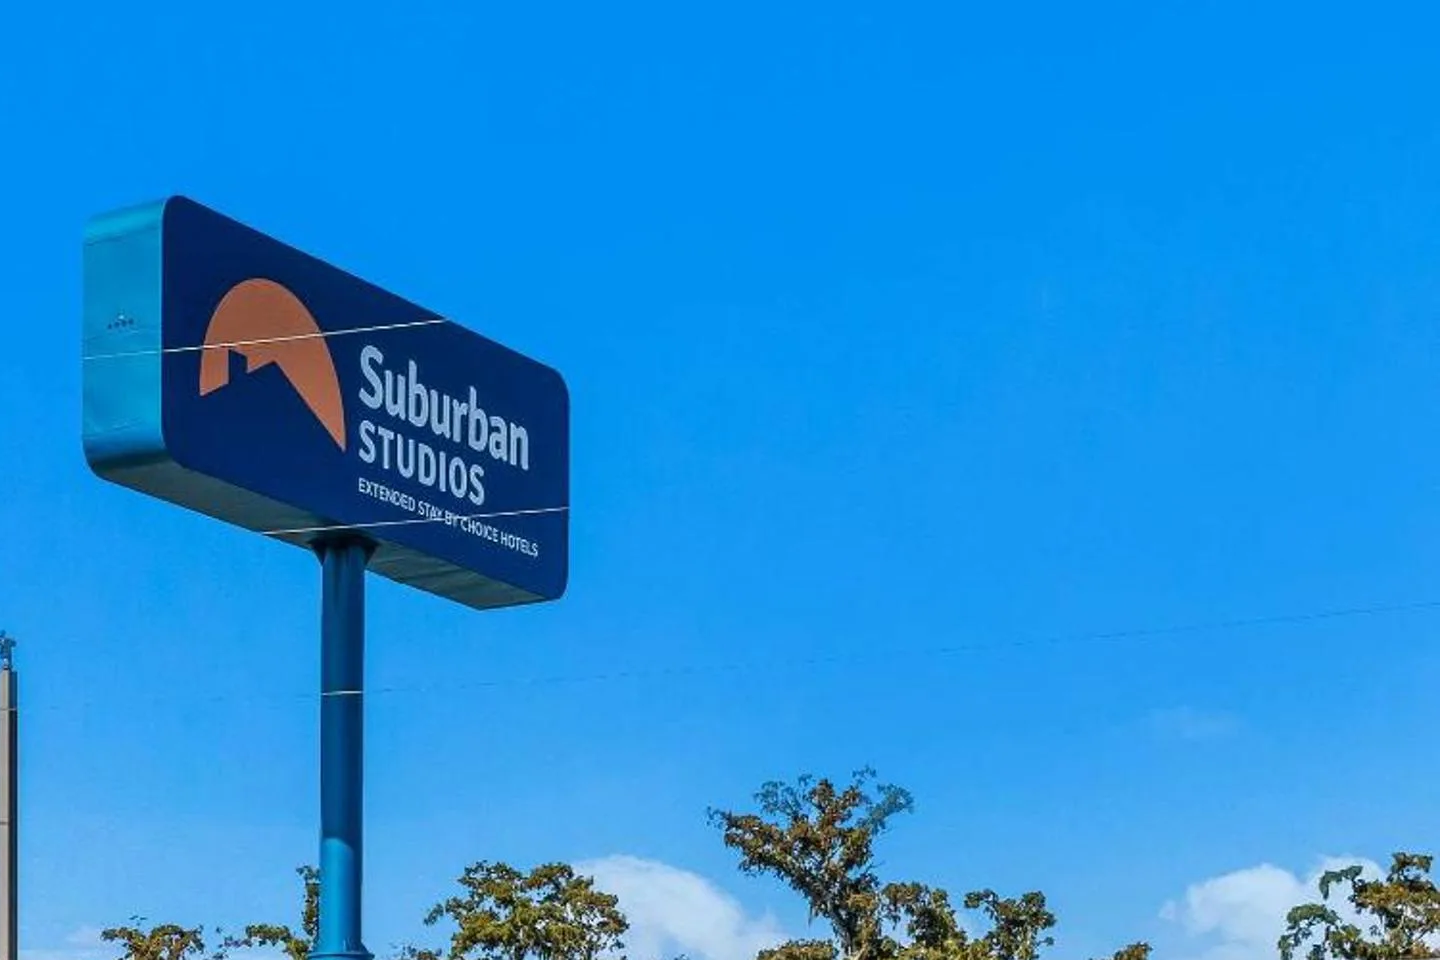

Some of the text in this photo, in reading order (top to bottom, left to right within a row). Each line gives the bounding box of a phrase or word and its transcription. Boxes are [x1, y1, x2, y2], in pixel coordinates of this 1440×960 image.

[359, 345, 529, 471] Suburban
[359, 420, 485, 505] STUDIOS
[358, 477, 538, 557] EXTENDED STAY BY CHOICE HOTELS
